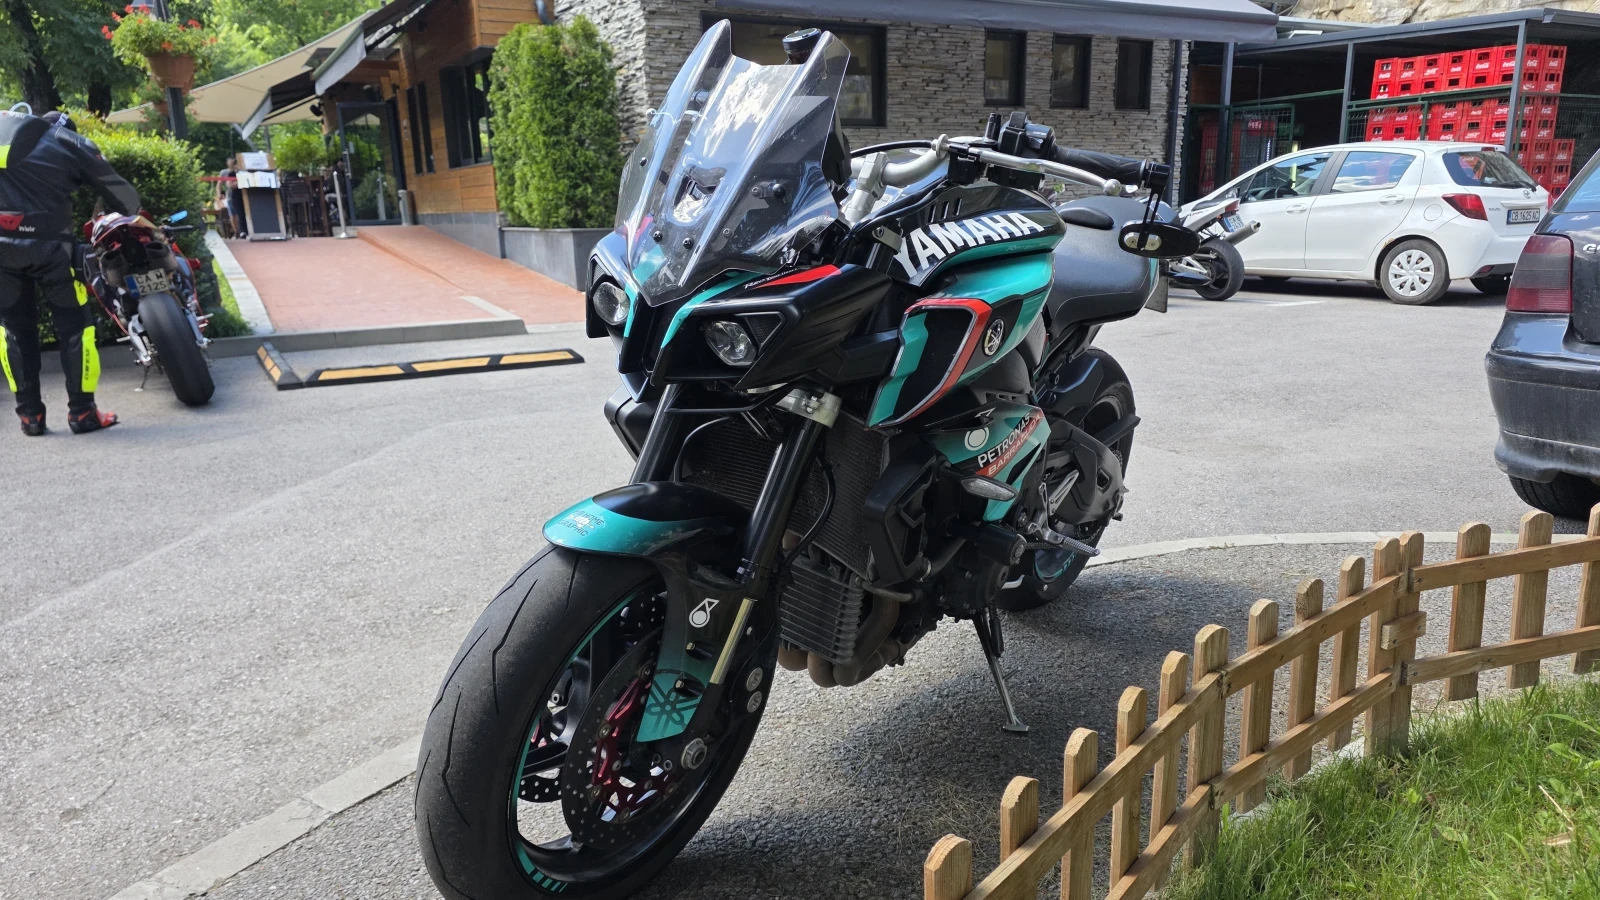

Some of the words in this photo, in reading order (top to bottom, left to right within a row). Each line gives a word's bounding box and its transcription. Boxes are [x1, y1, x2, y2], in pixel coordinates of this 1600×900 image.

[893, 212, 1044, 278] YAMAHA
[139, 280, 167, 293] 2125
[978, 412, 1030, 467] PETRONAS
